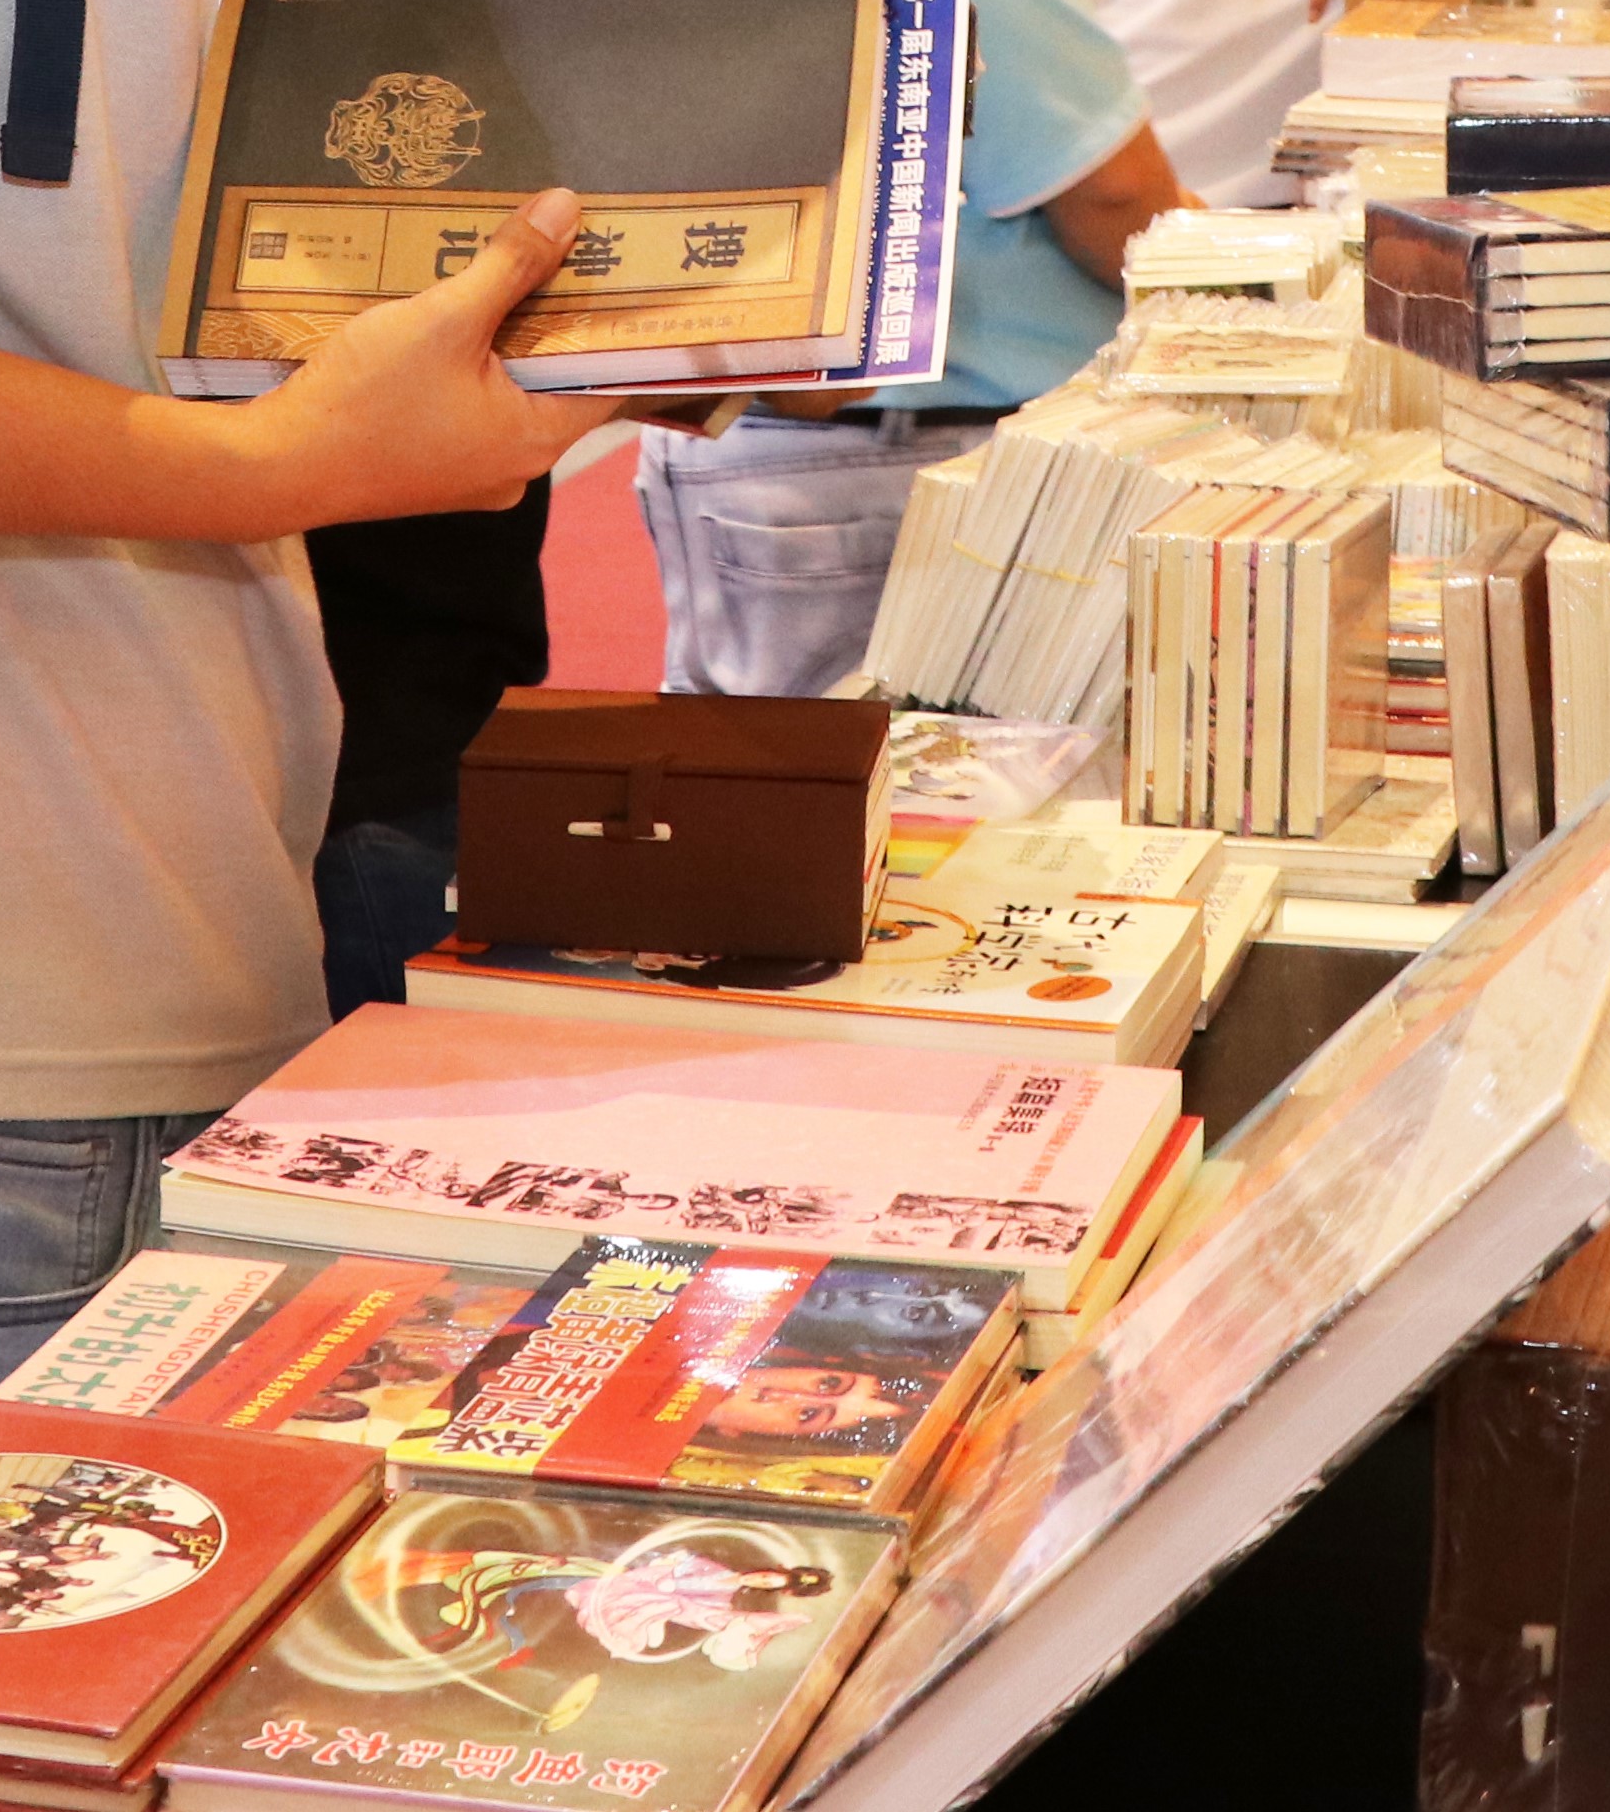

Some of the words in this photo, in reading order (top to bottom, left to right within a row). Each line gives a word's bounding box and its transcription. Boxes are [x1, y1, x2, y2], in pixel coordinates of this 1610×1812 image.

[1053, 910, 1137, 955] 古代
[241, 1718, 669, 1800] 钓鱼郎和龙女
